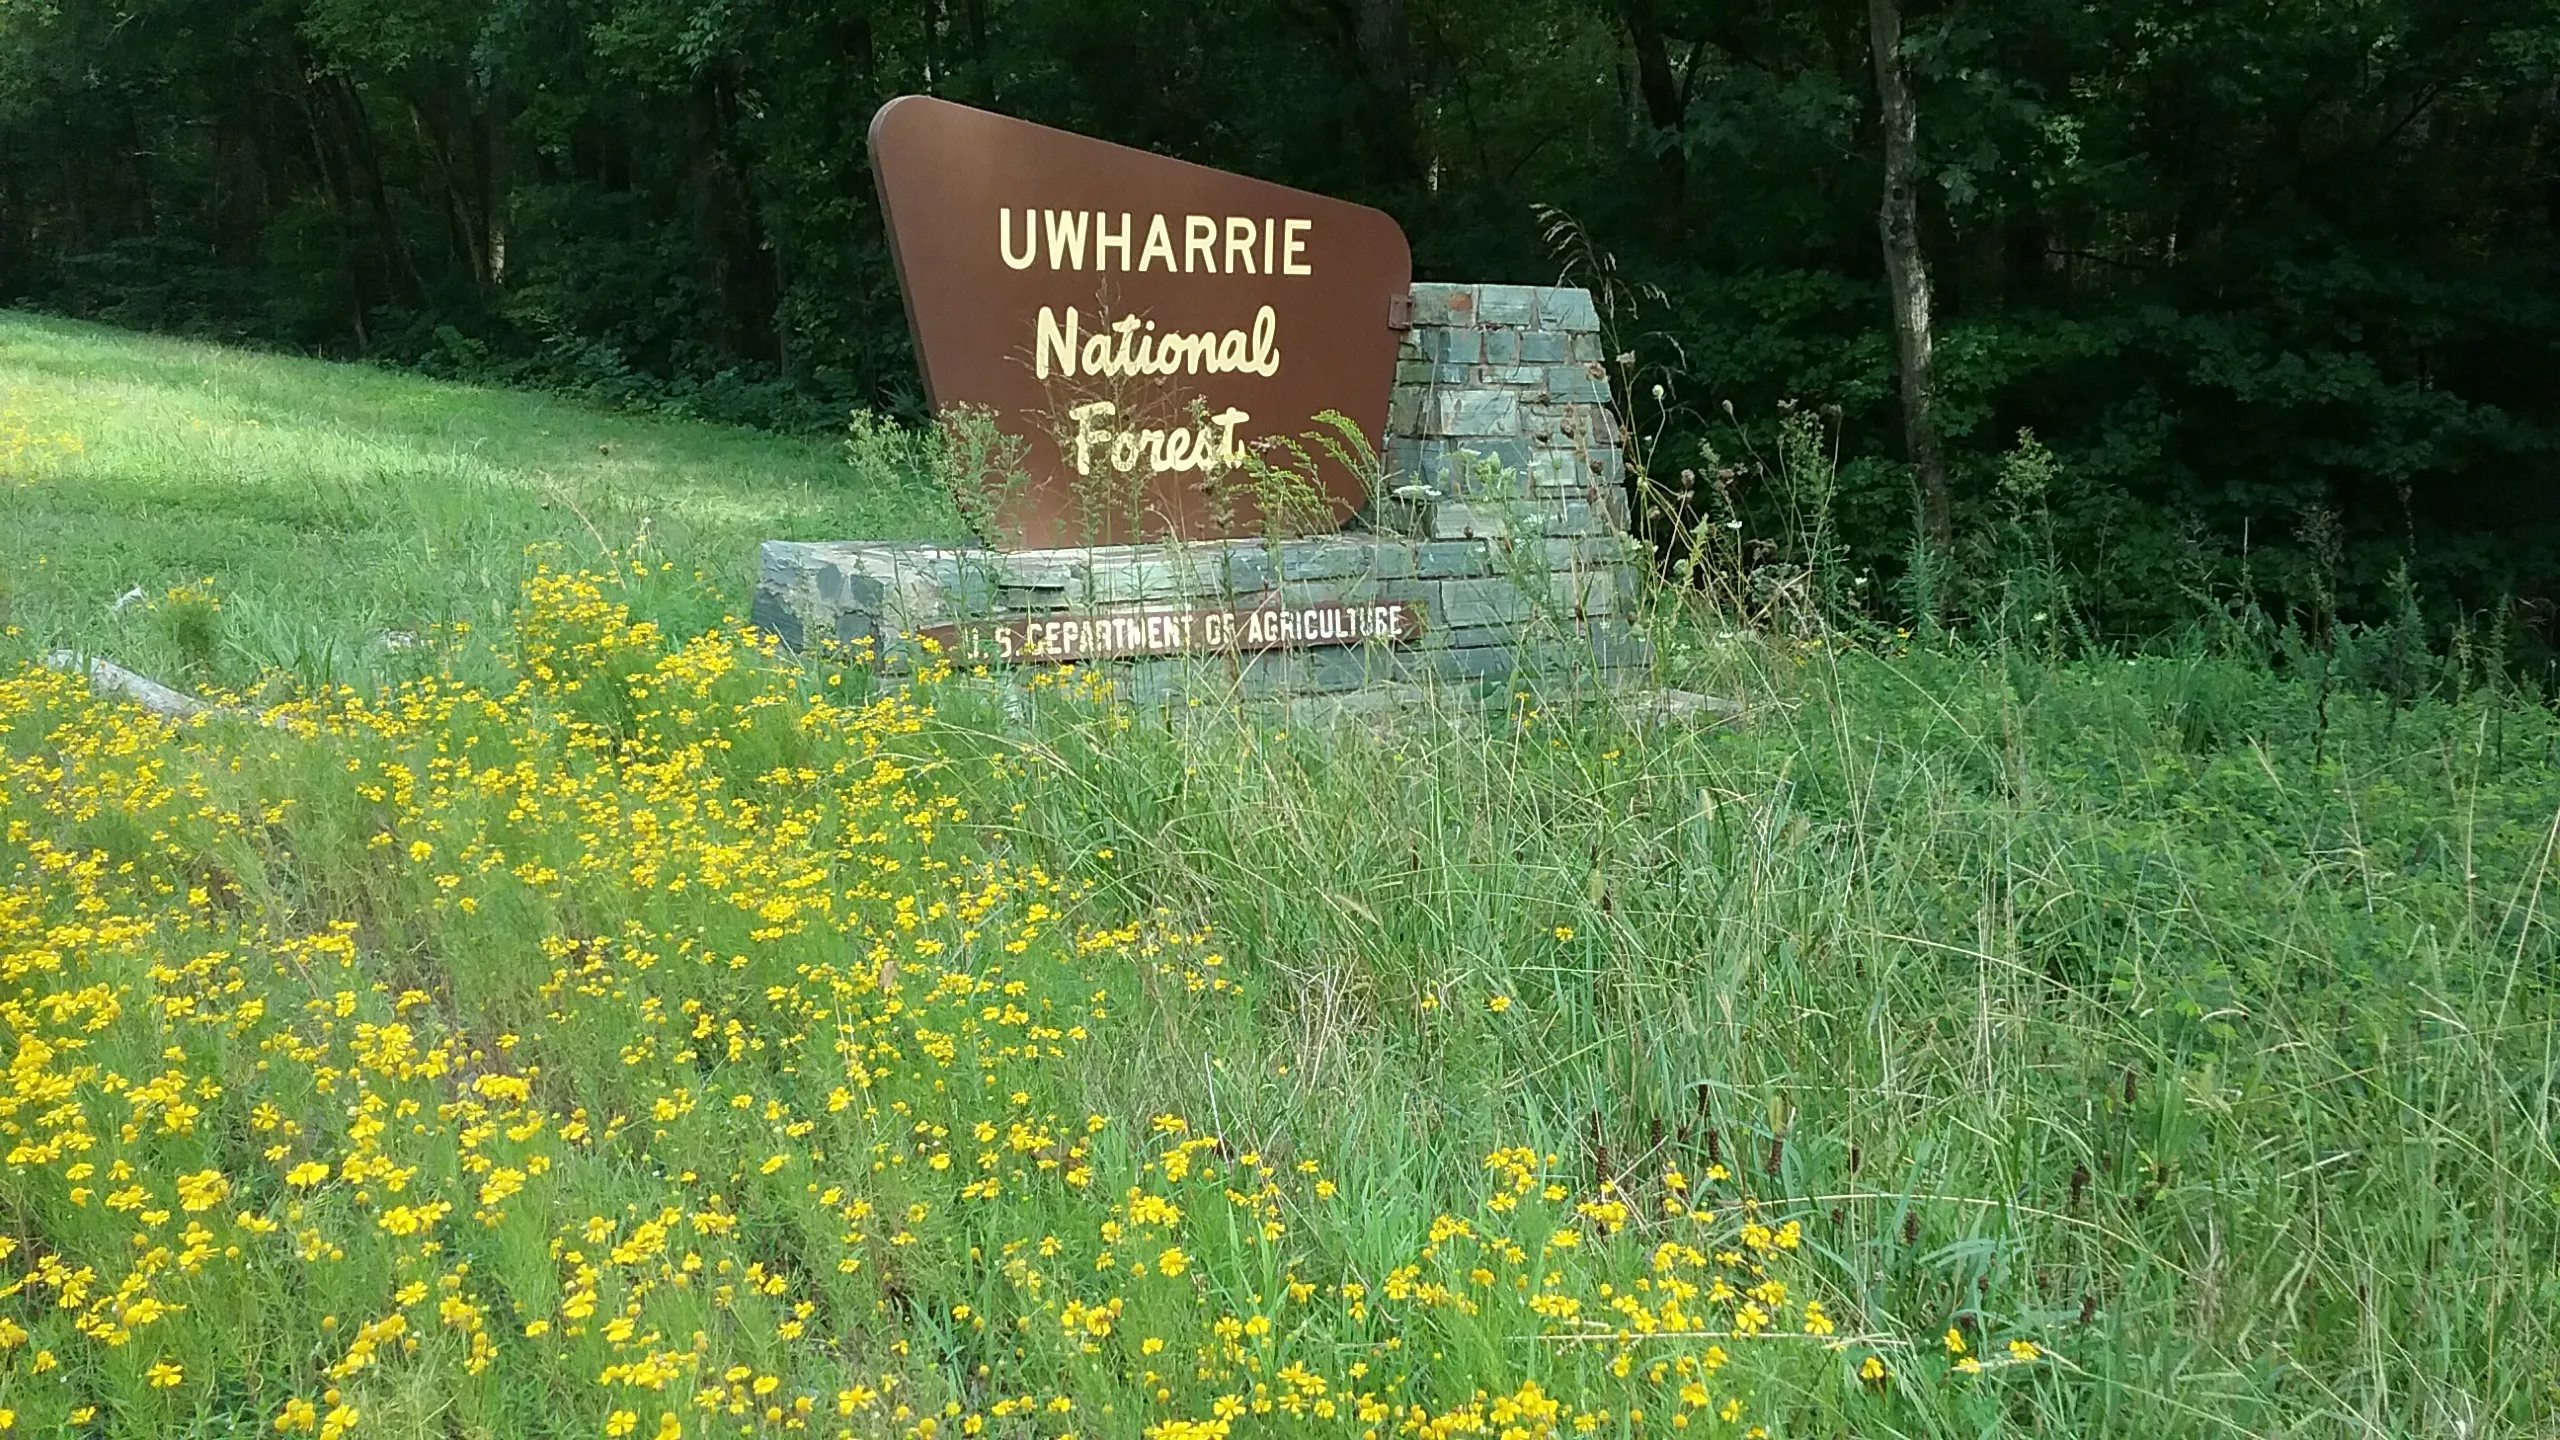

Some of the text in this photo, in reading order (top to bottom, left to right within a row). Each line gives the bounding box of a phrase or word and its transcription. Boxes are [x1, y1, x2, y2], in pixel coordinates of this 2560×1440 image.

[1000, 207, 1312, 275] UWHARRIE
[1036, 305, 1279, 379] National
[1069, 401, 1250, 475] Forest
[1248, 605, 1403, 644] AGRICULTURE
